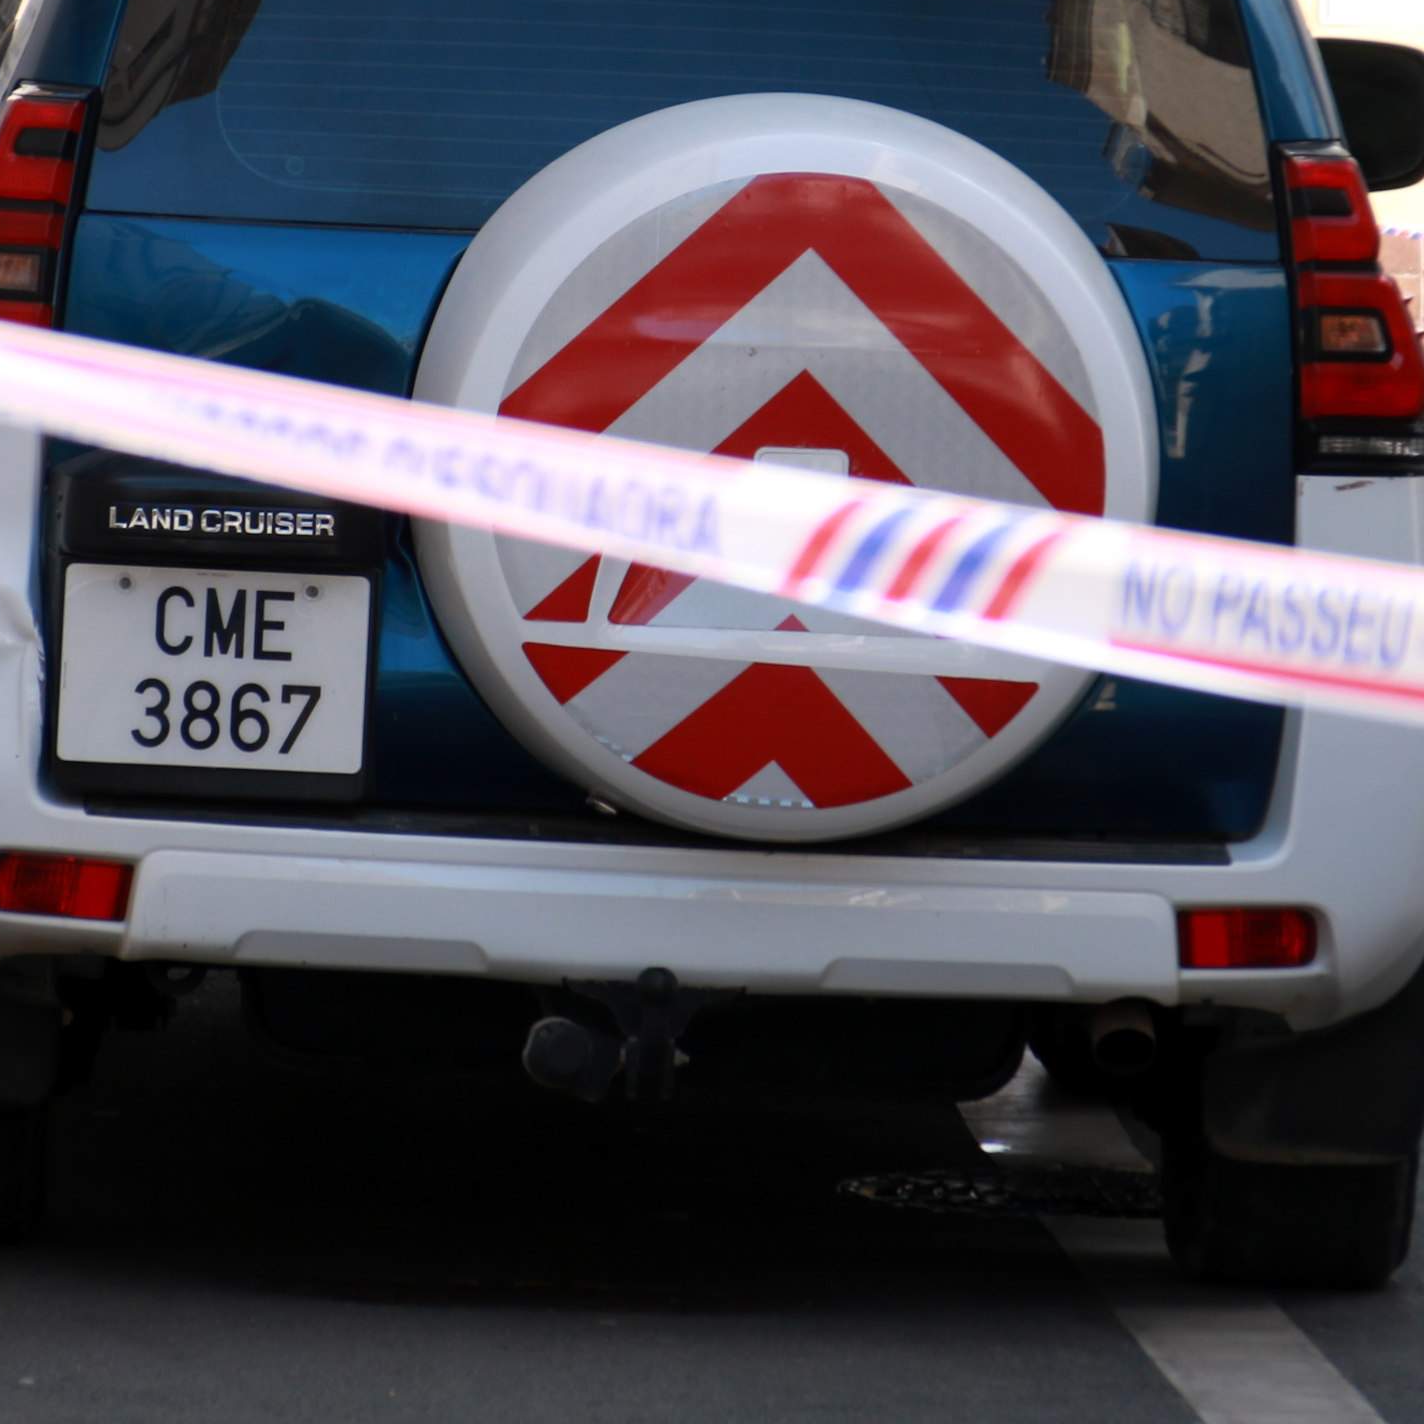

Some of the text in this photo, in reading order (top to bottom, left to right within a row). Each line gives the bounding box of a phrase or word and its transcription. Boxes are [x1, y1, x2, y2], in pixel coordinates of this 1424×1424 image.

[108, 505, 336, 538] LAND CRUISER
[155, 585, 295, 662] CME
[1120, 560, 1196, 638] NO
[1208, 572, 1414, 671] PASSEU
[131, 677, 321, 756] 3867
